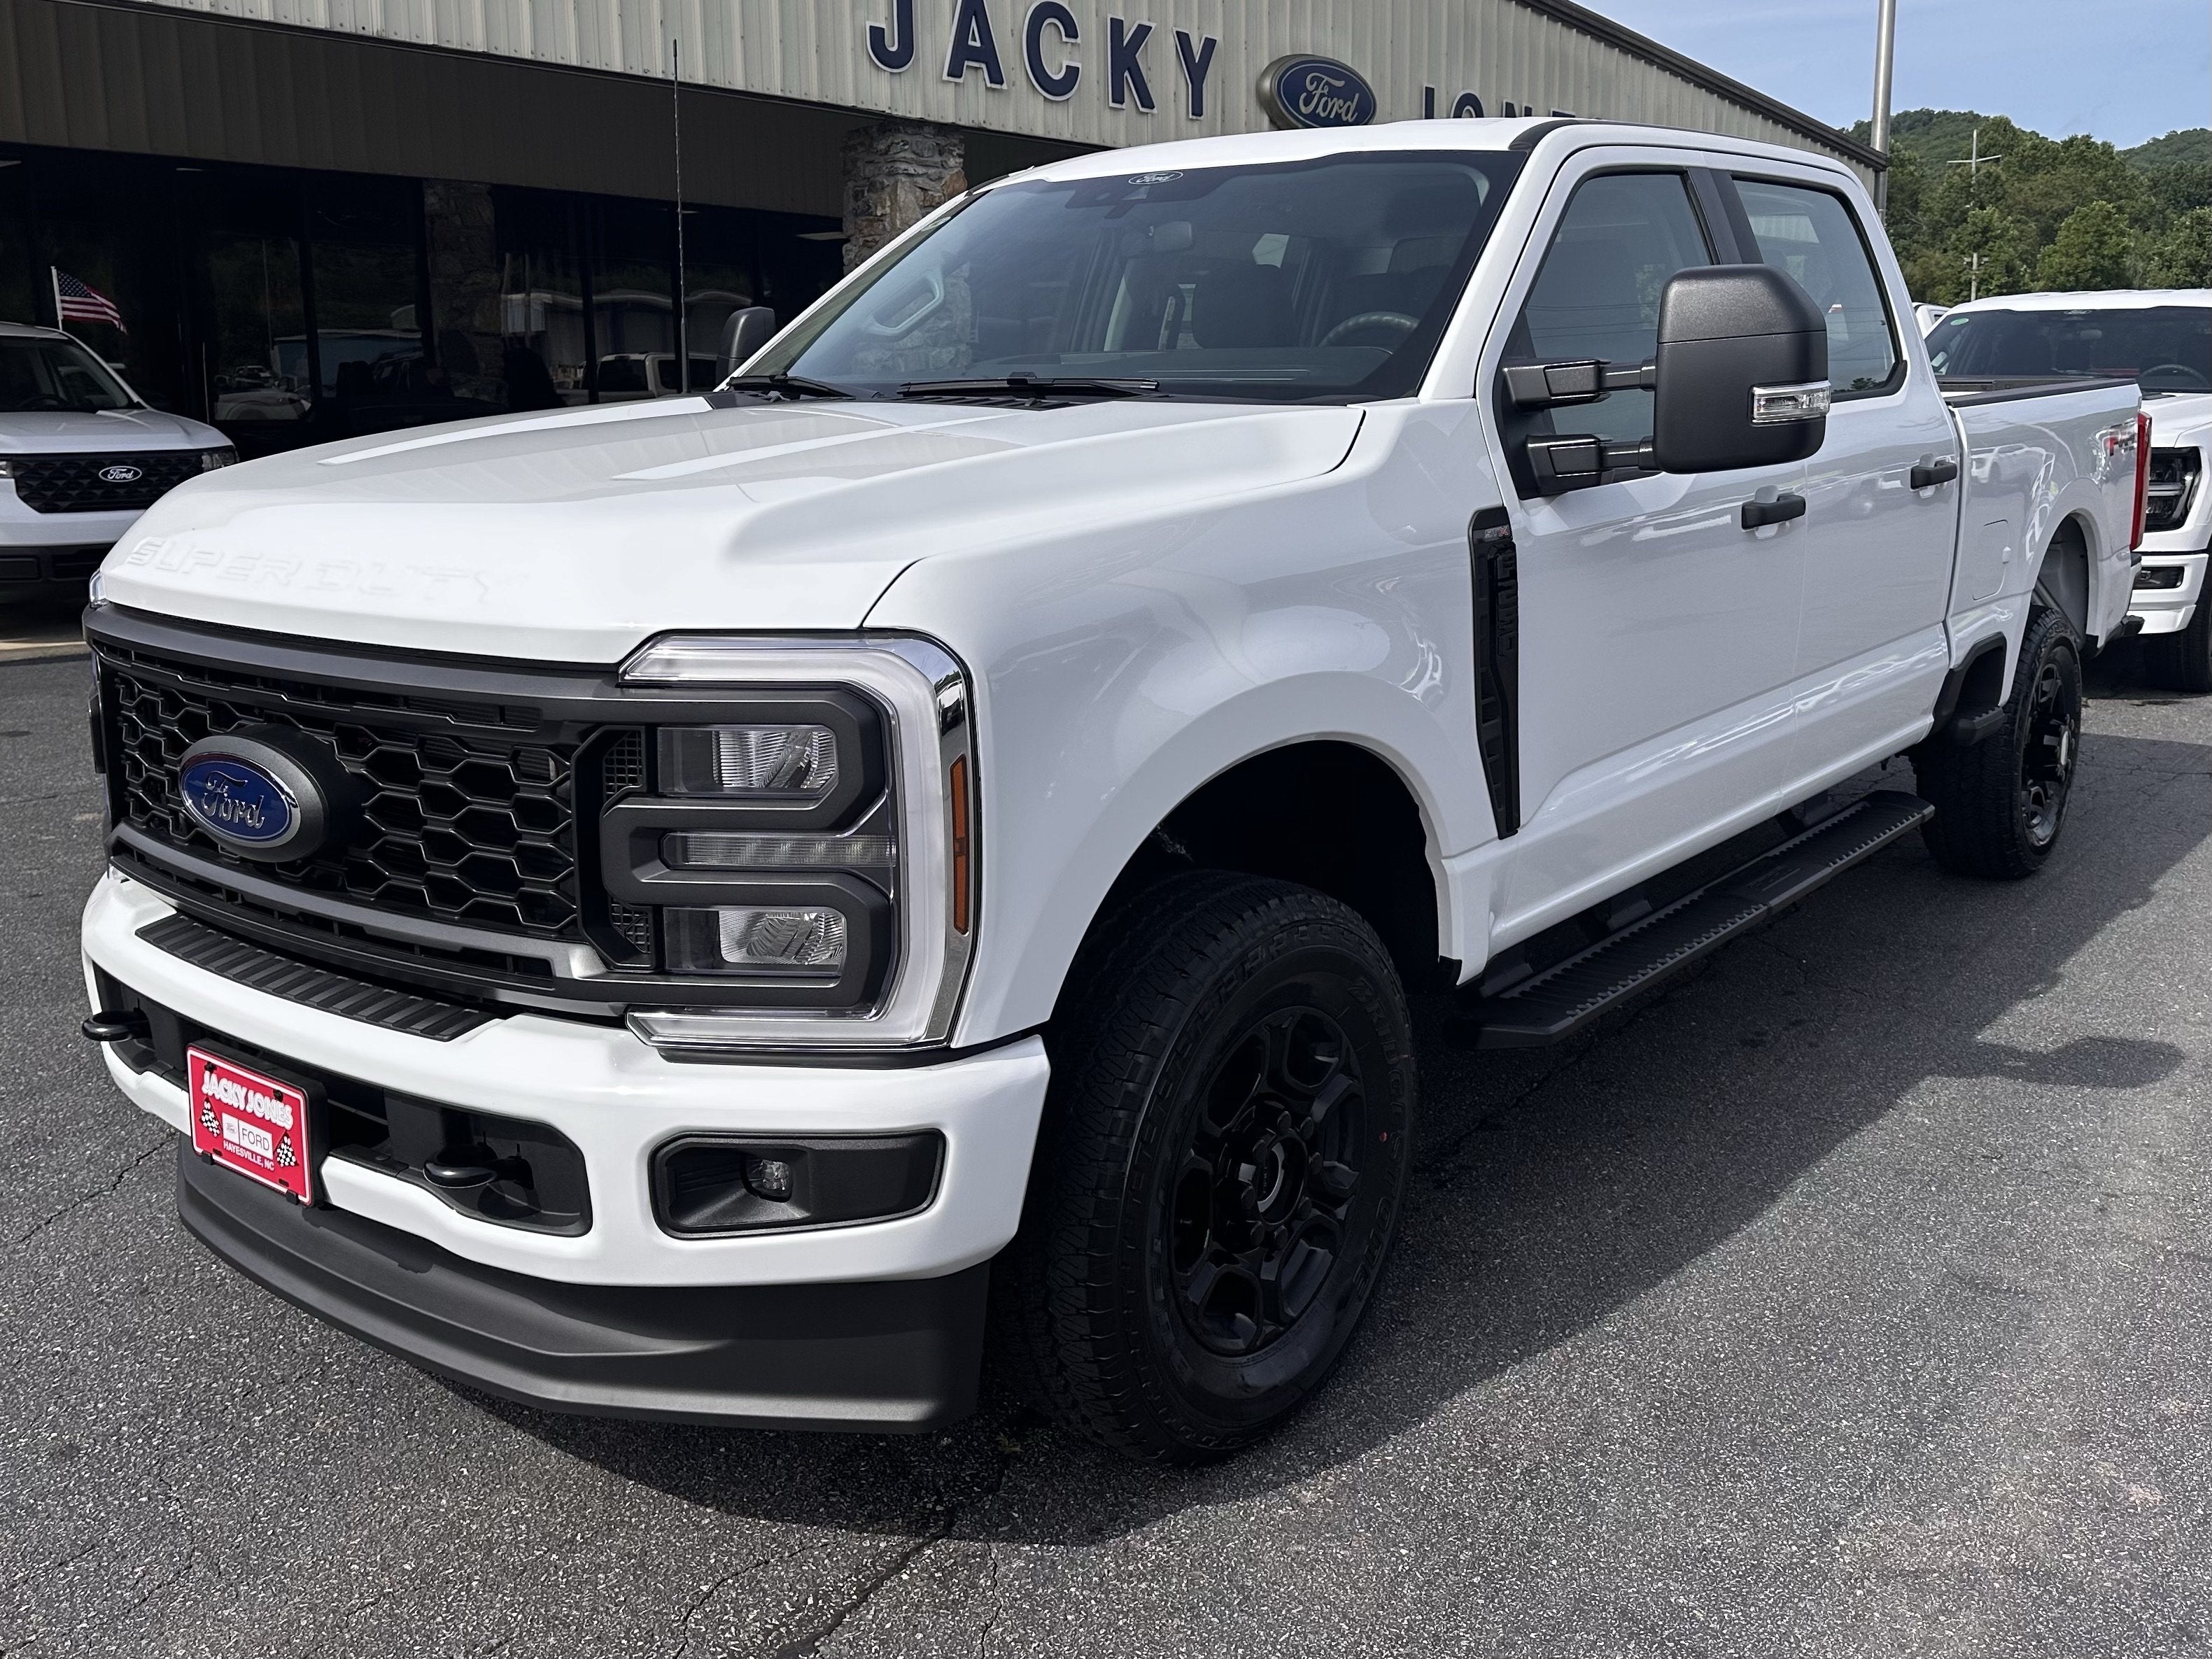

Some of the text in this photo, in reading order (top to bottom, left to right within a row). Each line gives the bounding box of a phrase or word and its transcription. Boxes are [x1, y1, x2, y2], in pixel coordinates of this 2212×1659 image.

[866, 0, 1218, 120] JACKY
[1299, 72, 1360, 122] Ford
[125, 536, 303, 588] SUPER
[201, 770, 265, 829] Ford
[201, 1070, 294, 1131] JACKY JONES
[223, 1140, 275, 1171] HAYESVILLE, NC
[241, 1127, 270, 1152] FORD
